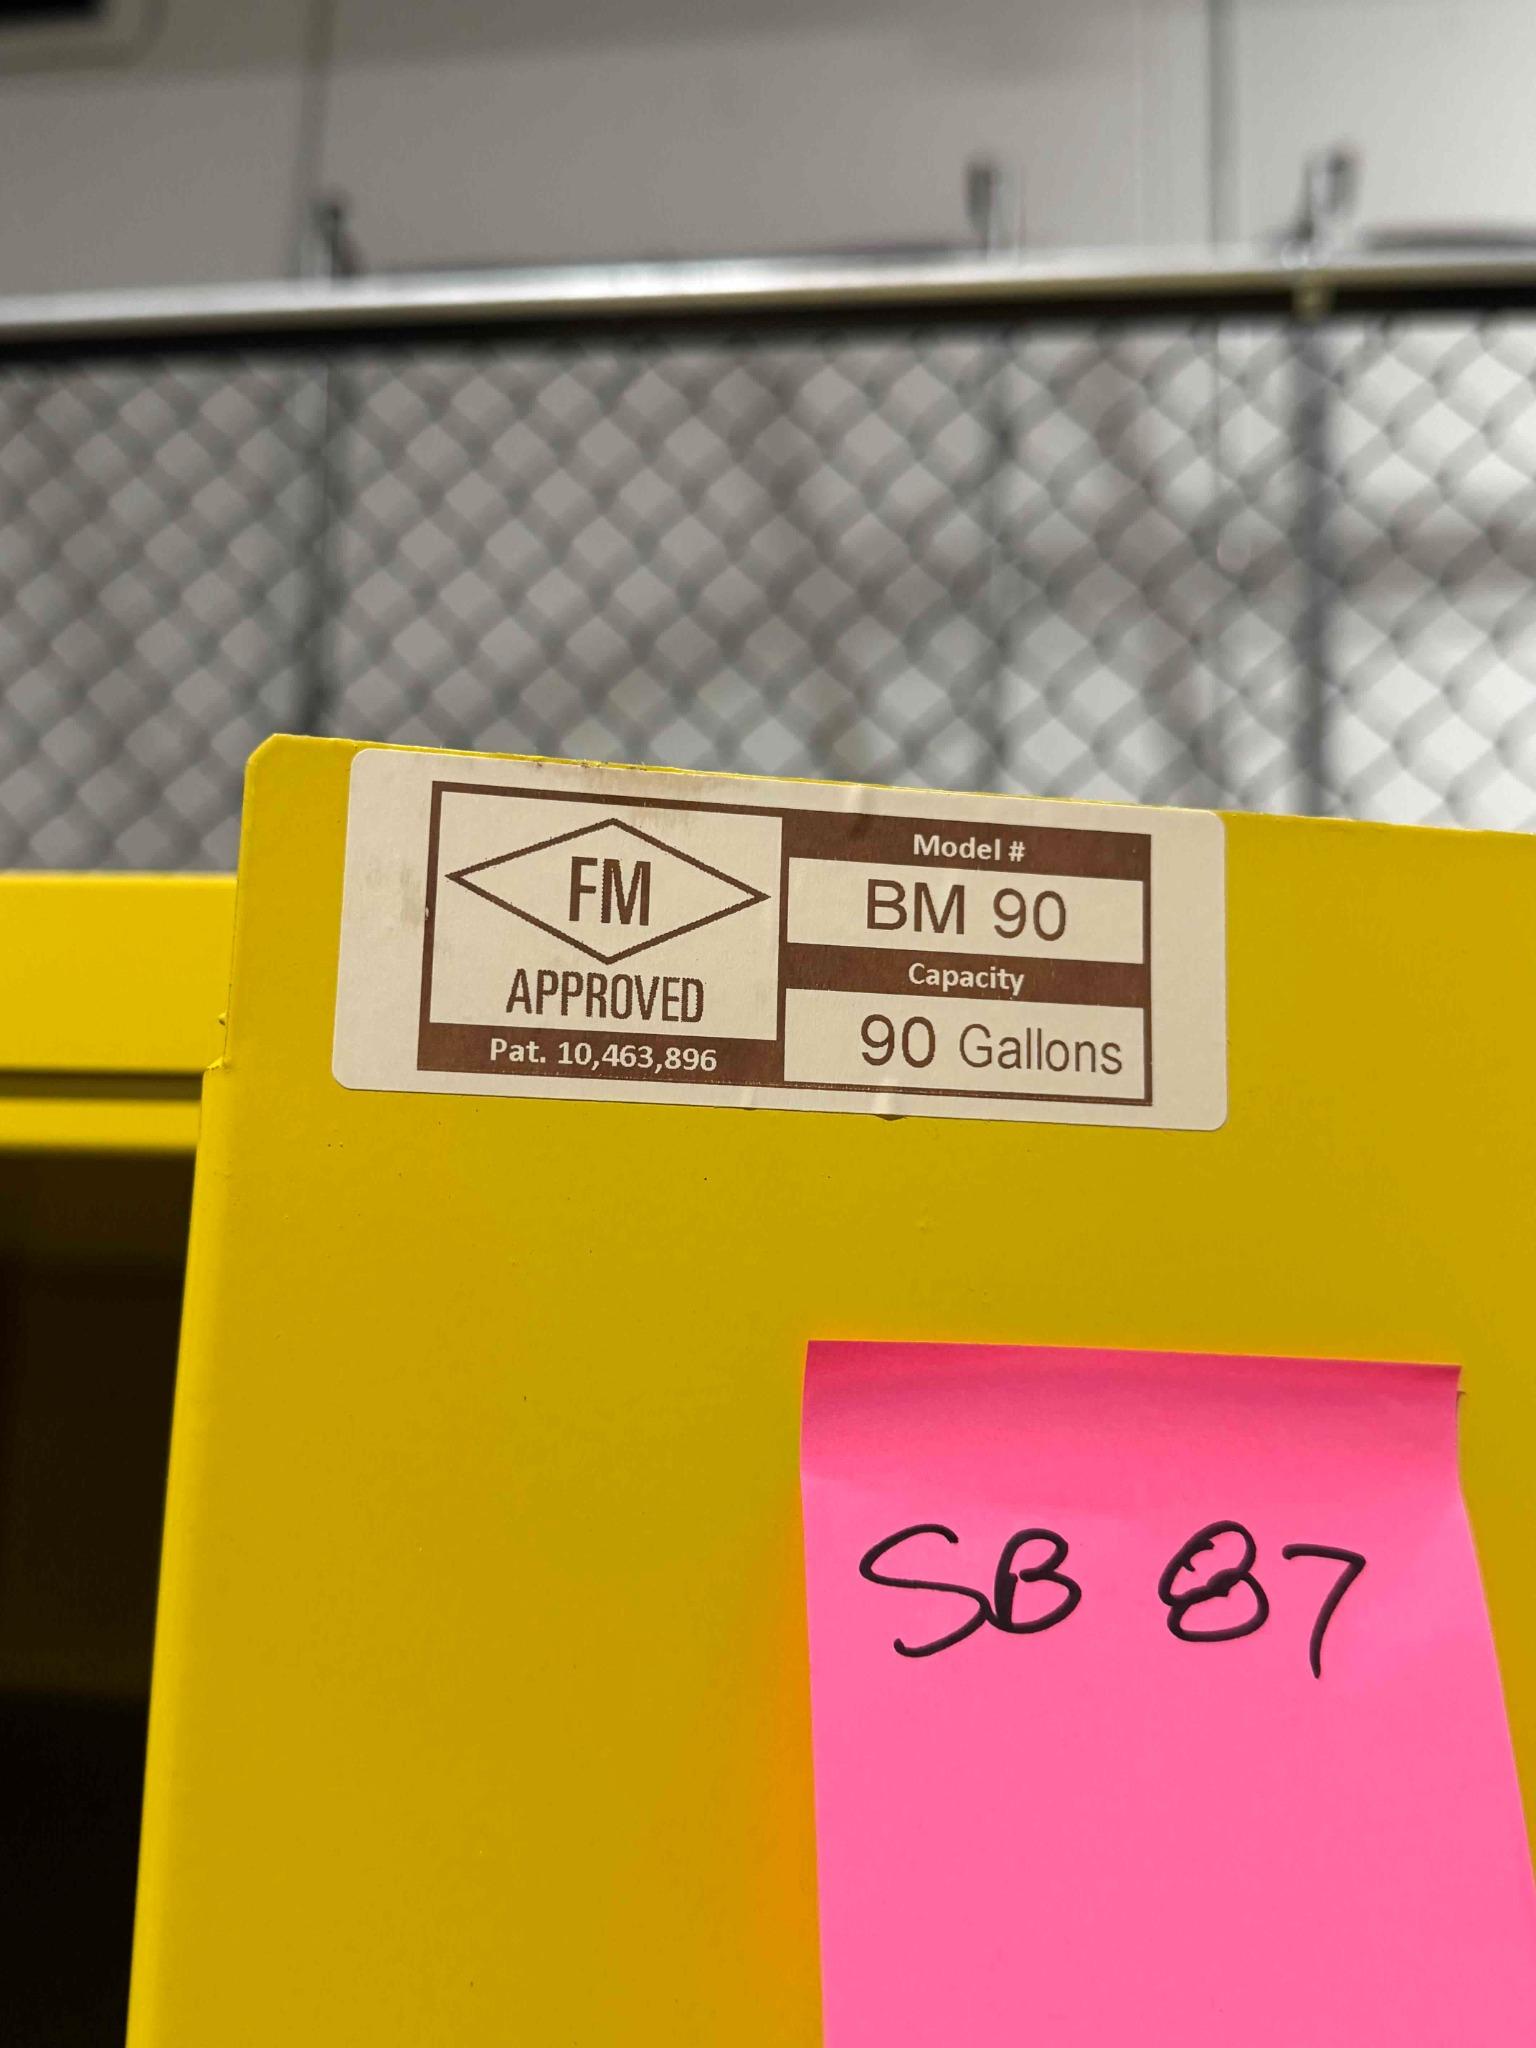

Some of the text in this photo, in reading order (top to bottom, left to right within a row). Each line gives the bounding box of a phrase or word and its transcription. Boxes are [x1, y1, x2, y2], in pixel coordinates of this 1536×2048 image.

[913, 834, 1026, 862] Model #
[568, 856, 652, 926] FM
[866, 878, 1067, 941] BM 90
[506, 968, 705, 1023] APPROVED
[908, 962, 1025, 996] Capacity
[490, 1038, 718, 1073] Pat. 10,463,896
[861, 1014, 1123, 1075] 90 Gallons
[858, 1520, 1367, 1680] SB 87
